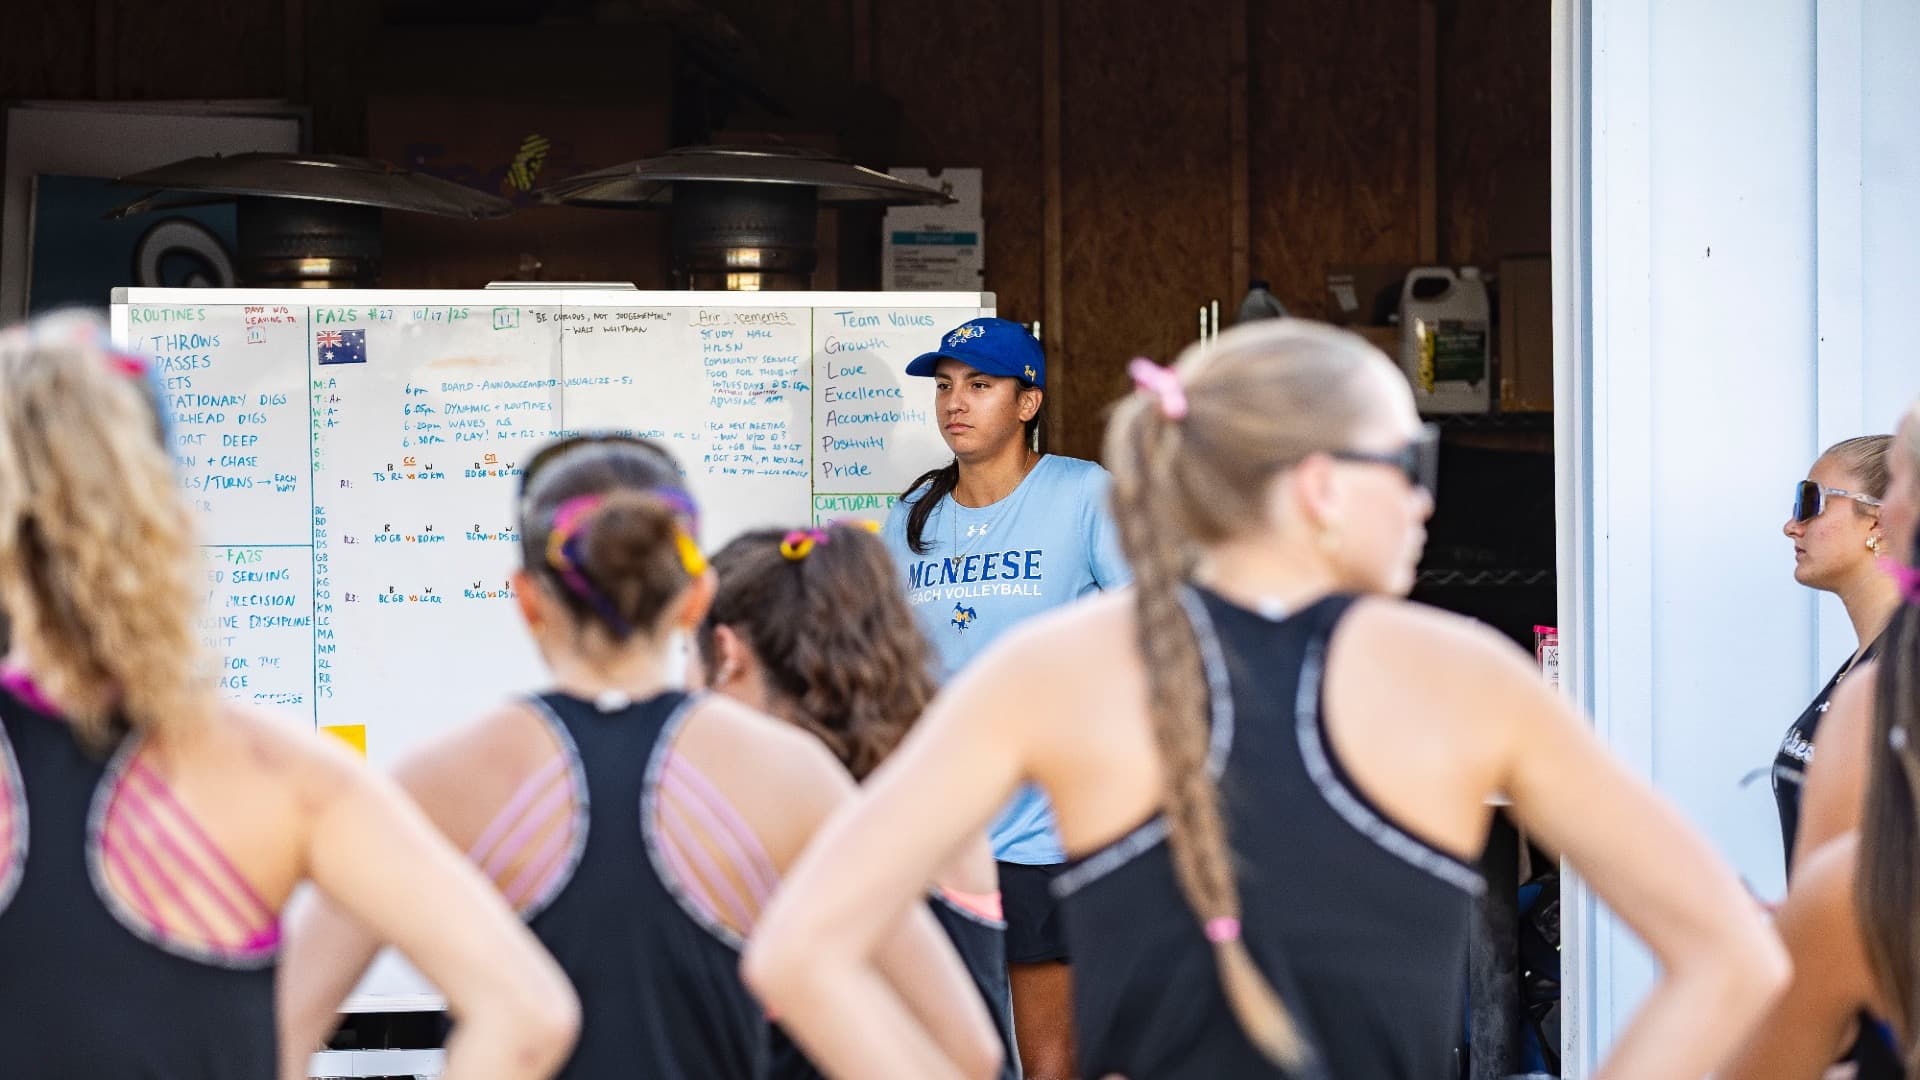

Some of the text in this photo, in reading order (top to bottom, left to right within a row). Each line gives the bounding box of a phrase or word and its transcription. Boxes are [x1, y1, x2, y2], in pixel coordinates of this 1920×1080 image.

[131, 308, 206, 323] ROUTINES
[316, 308, 358, 325] FA25
[367, 307, 394, 320] #27
[593, 312, 609, 321] NOT
[833, 311, 935, 328] Team Values
[603, 325, 648, 335] WHITMAN
[151, 334, 220, 353] THROWS
[824, 335, 889, 355] Growth
[706, 369, 728, 378] FOOD
[826, 362, 867, 381] Love
[328, 378, 337, 389] A
[166, 394, 287, 409] TATIONARY DIGS
[825, 387, 905, 404] Excellence
[239, 412, 267, 424] DIGS
[448, 418, 486, 429] WAVES
[826, 409, 928, 428] Accountability
[223, 433, 258, 447] DEEP
[822, 435, 886, 453] Positivity
[221, 455, 258, 468] CHASE
[822, 456, 872, 479] Pride
[275, 473, 297, 482] EACH
[276, 483, 296, 493] WAY
[814, 495, 882, 512] CULTURAL
[232, 568, 290, 584] SERVING
[911, 583, 1042, 605] EACH VOLLEYBALL
[316, 603, 333, 614] KM
[249, 614, 311, 630] DISCIPLINE
[318, 616, 330, 626] LC
[318, 629, 334, 640] MA
[318, 643, 336, 654] MM
[224, 656, 248, 670] FOR
[318, 685, 333, 698] TS
